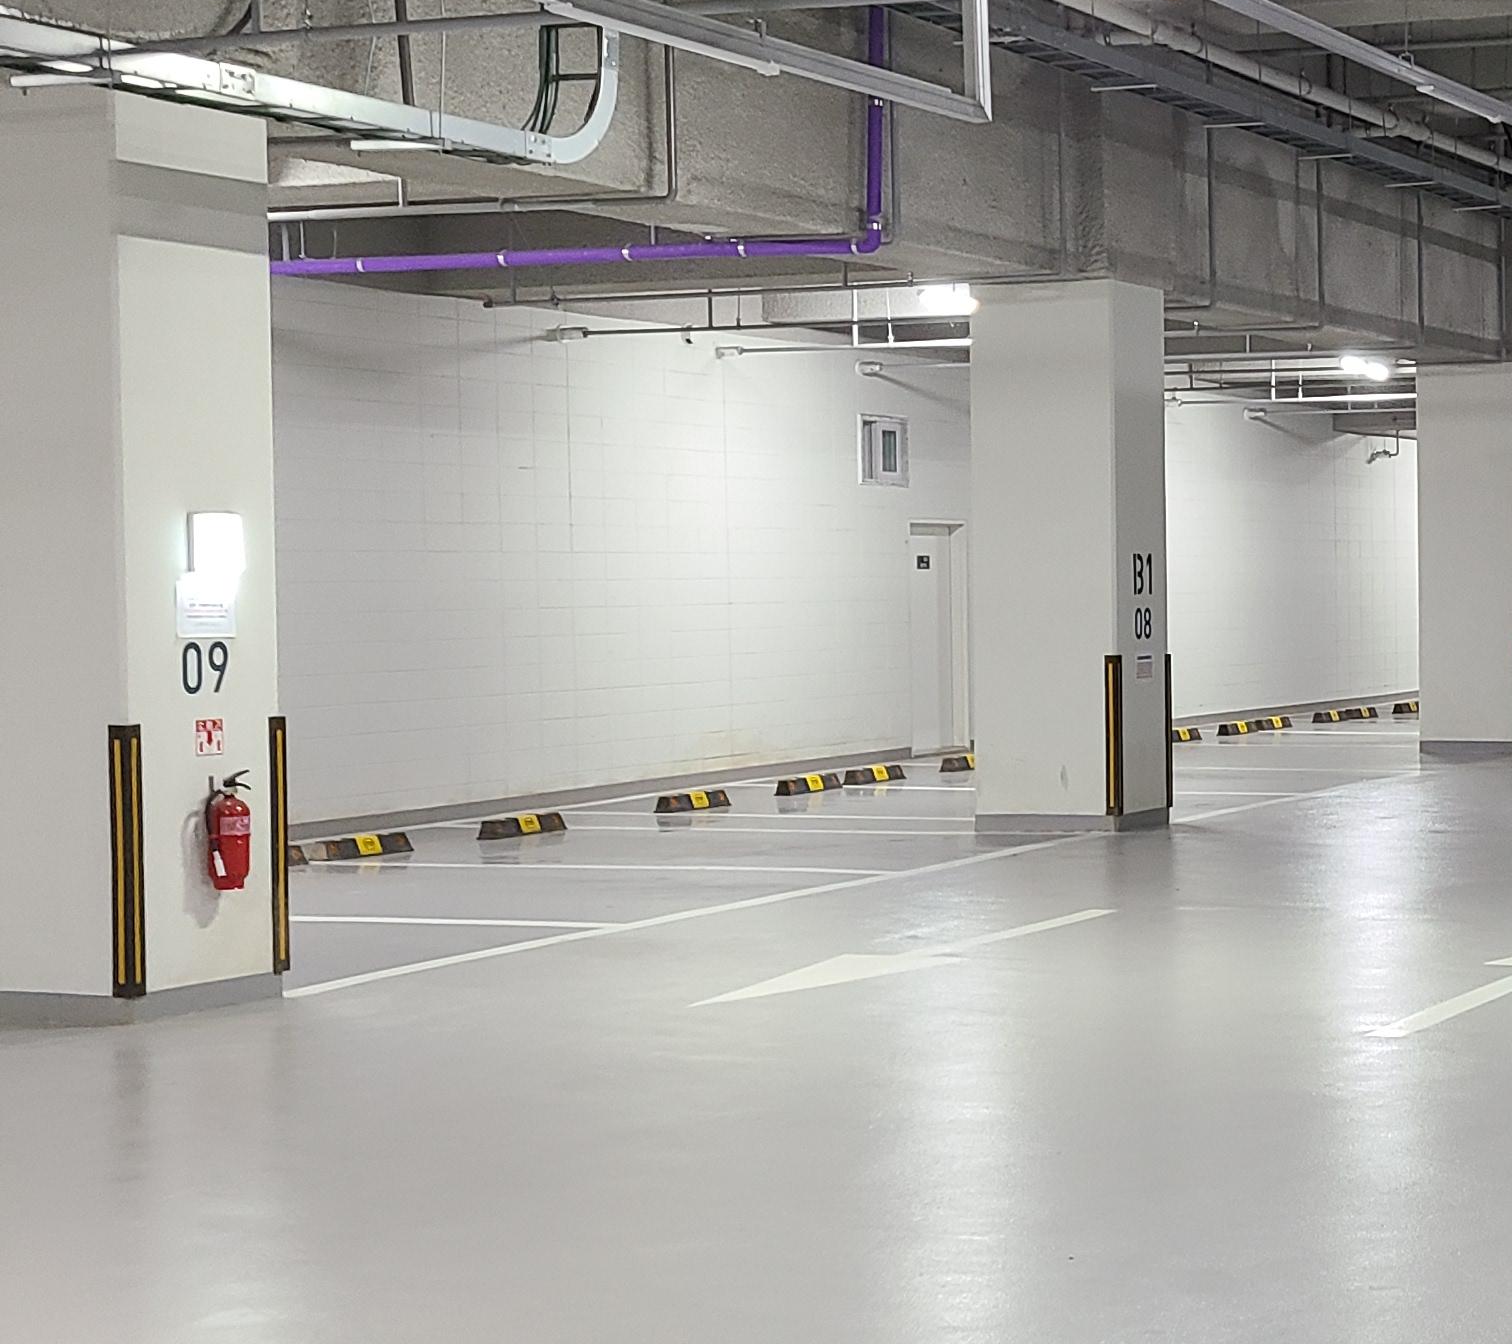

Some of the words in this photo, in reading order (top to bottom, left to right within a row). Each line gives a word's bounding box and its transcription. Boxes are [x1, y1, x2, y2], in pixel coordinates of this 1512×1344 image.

[1132, 553, 1153, 594] B1
[1134, 607, 1152, 640] 08
[182, 641, 229, 695] 09
